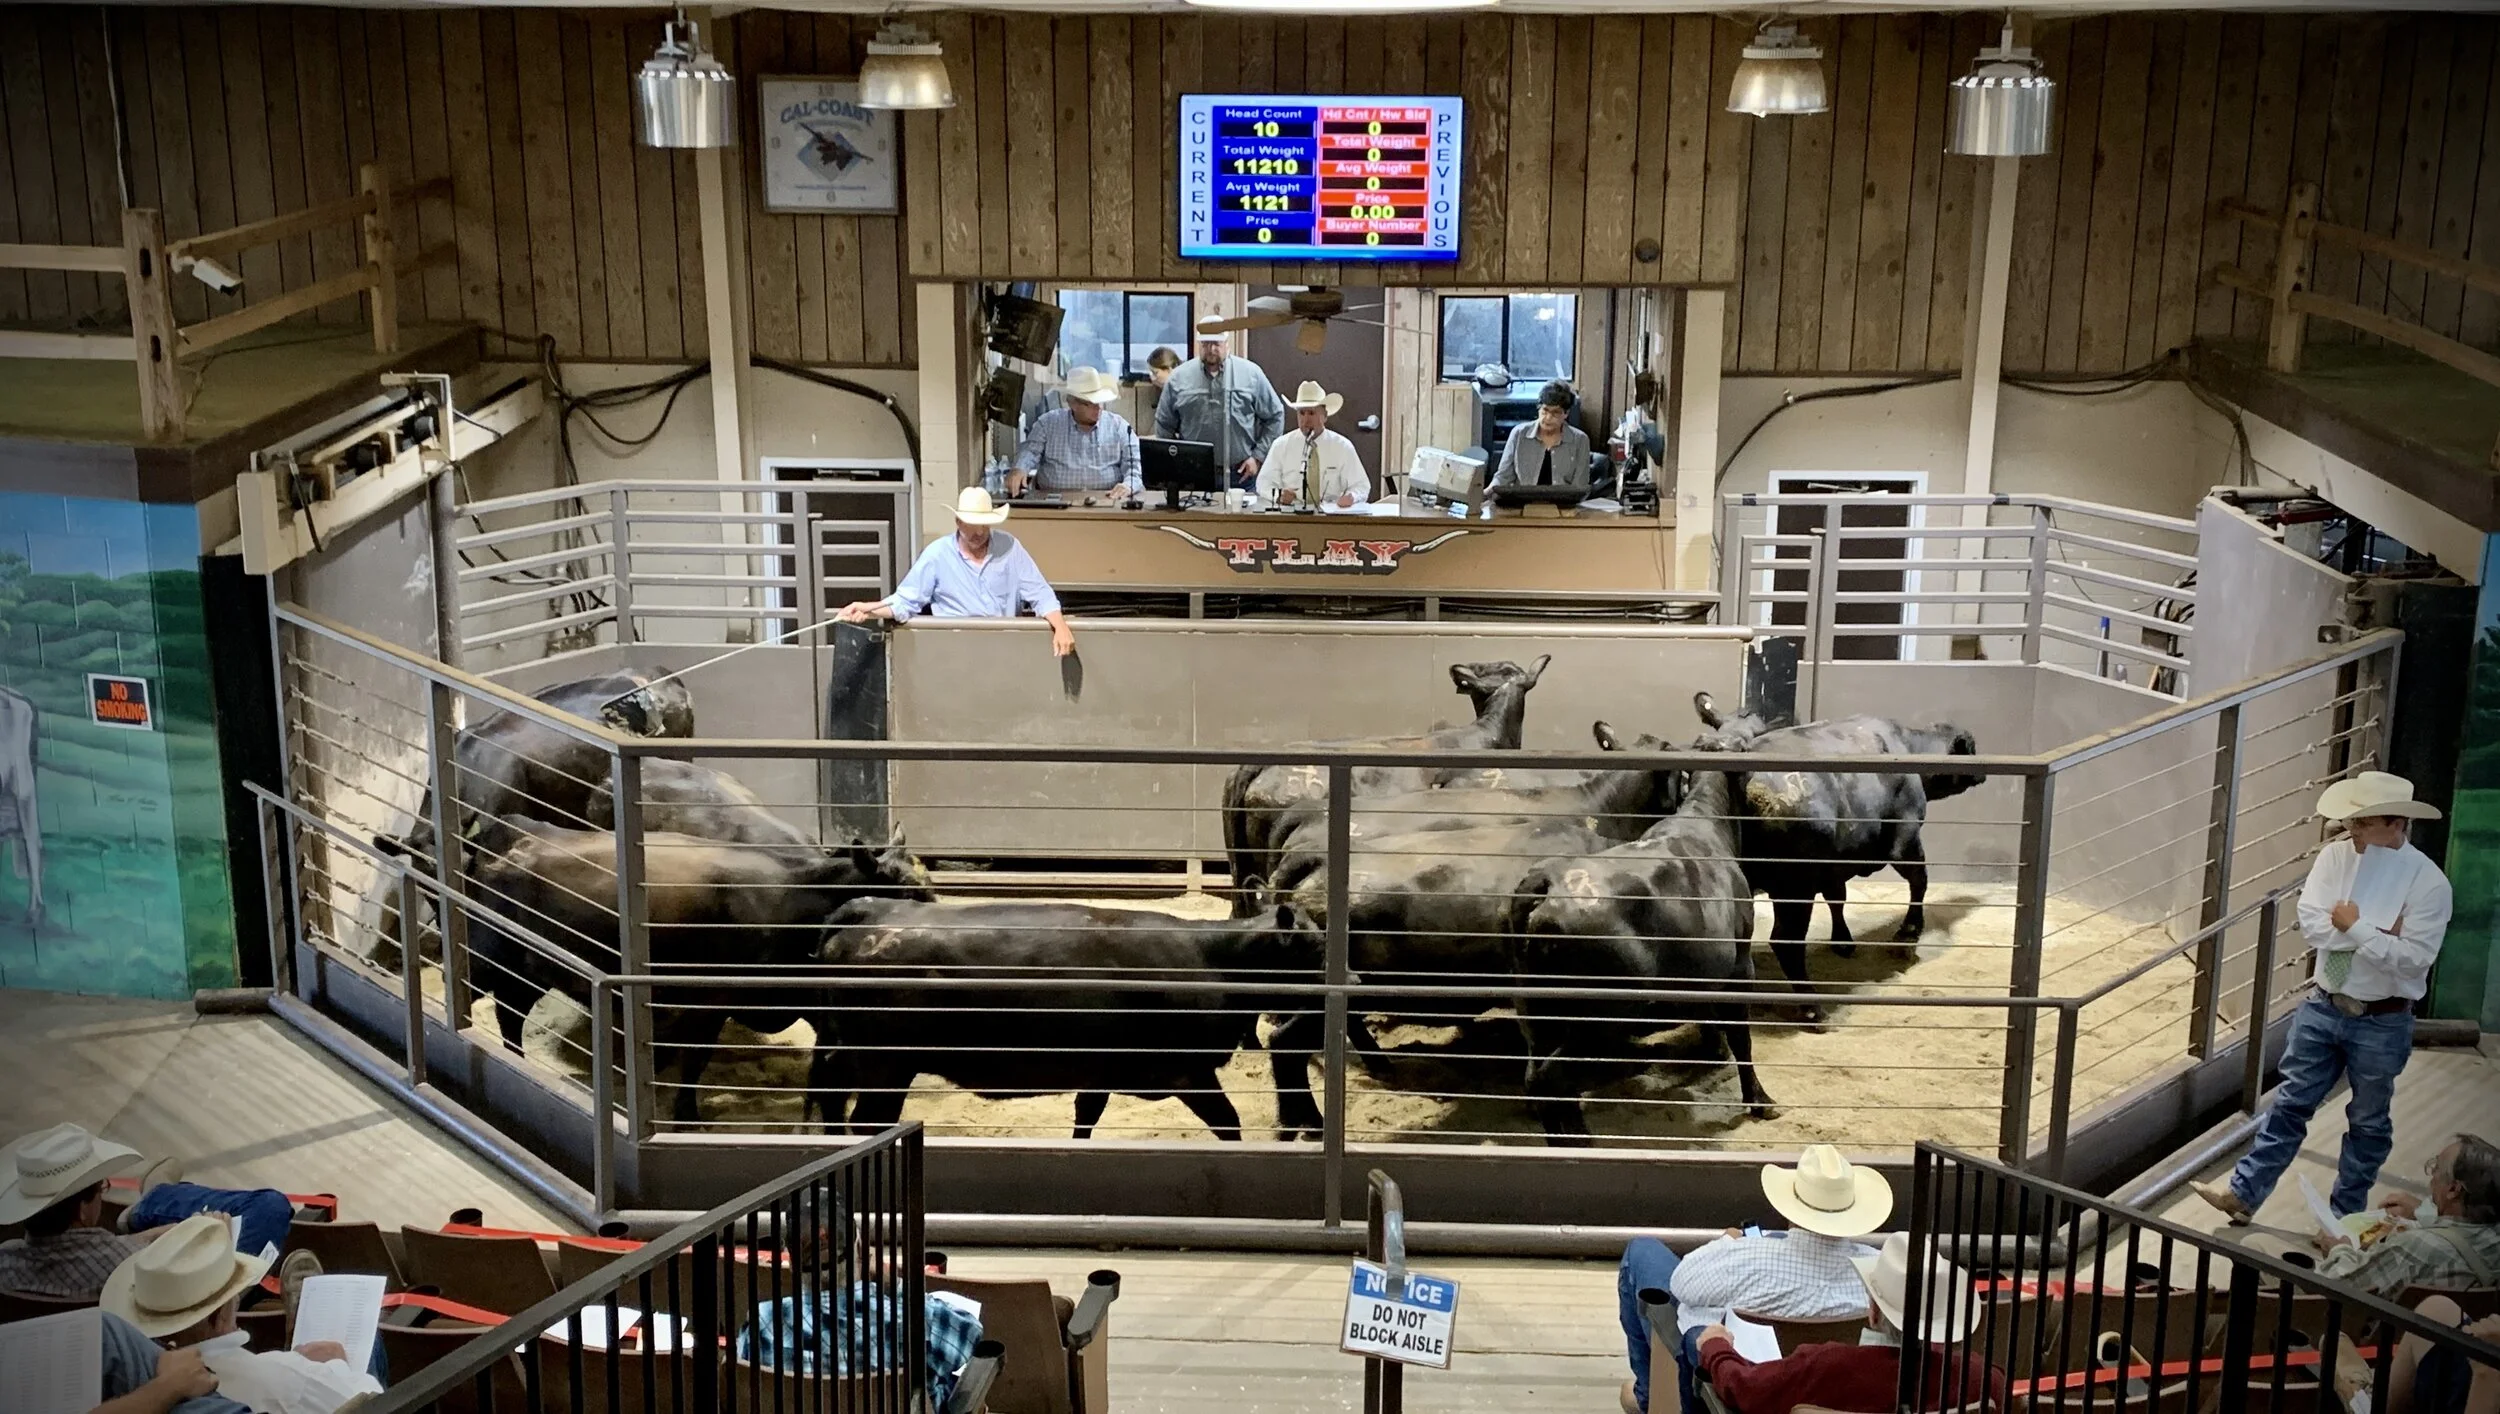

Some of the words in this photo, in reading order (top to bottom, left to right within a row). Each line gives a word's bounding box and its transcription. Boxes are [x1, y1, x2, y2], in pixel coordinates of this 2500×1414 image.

[780, 98, 875, 127] CAL-COAST
[1225, 108, 1259, 119] Head
[1263, 108, 1302, 119] Count
[1323, 109, 1342, 120] Hd
[1345, 109, 1369, 120] Cnt
[1371, 109, 1377, 120] /
[1253, 121, 1280, 137] 10
[1368, 121, 1382, 136] 0
[1335, 136, 1366, 147] Total
[1369, 136, 1415, 149] Weight
[1223, 145, 1255, 155] Total
[1259, 145, 1305, 158] Weight
[1367, 147, 1381, 162] 0
[1233, 158, 1299, 175] 11210
[1336, 163, 1362, 175] Avg
[1365, 163, 1412, 175] Weight
[1191, 111, 1206, 242] CURRENT
[1367, 176, 1380, 191] 0
[1433, 113, 1452, 247] PREVIOUS
[1225, 181, 1251, 194] Avg
[1254, 181, 1300, 195] Weight
[1239, 195, 1289, 211] 1121
[1355, 193, 1390, 204] Price
[1350, 204, 1395, 220] 0.00
[1246, 215, 1279, 226] Price
[1326, 220, 1366, 232] Buyer
[1368, 220, 1422, 231] Number
[1257, 227, 1272, 243] 0
[1366, 232, 1380, 247] 0
[1217, 537, 1411, 571] TLAY
[110, 682, 129, 701] NO
[96, 699, 147, 721] SMOKING
[1365, 1273, 1444, 1305] NICE
[1372, 1304, 1393, 1324] DO
[1397, 1308, 1428, 1330] NOT
[1350, 1322, 1399, 1347] BLOCK
[1401, 1333, 1444, 1356] AISLE
